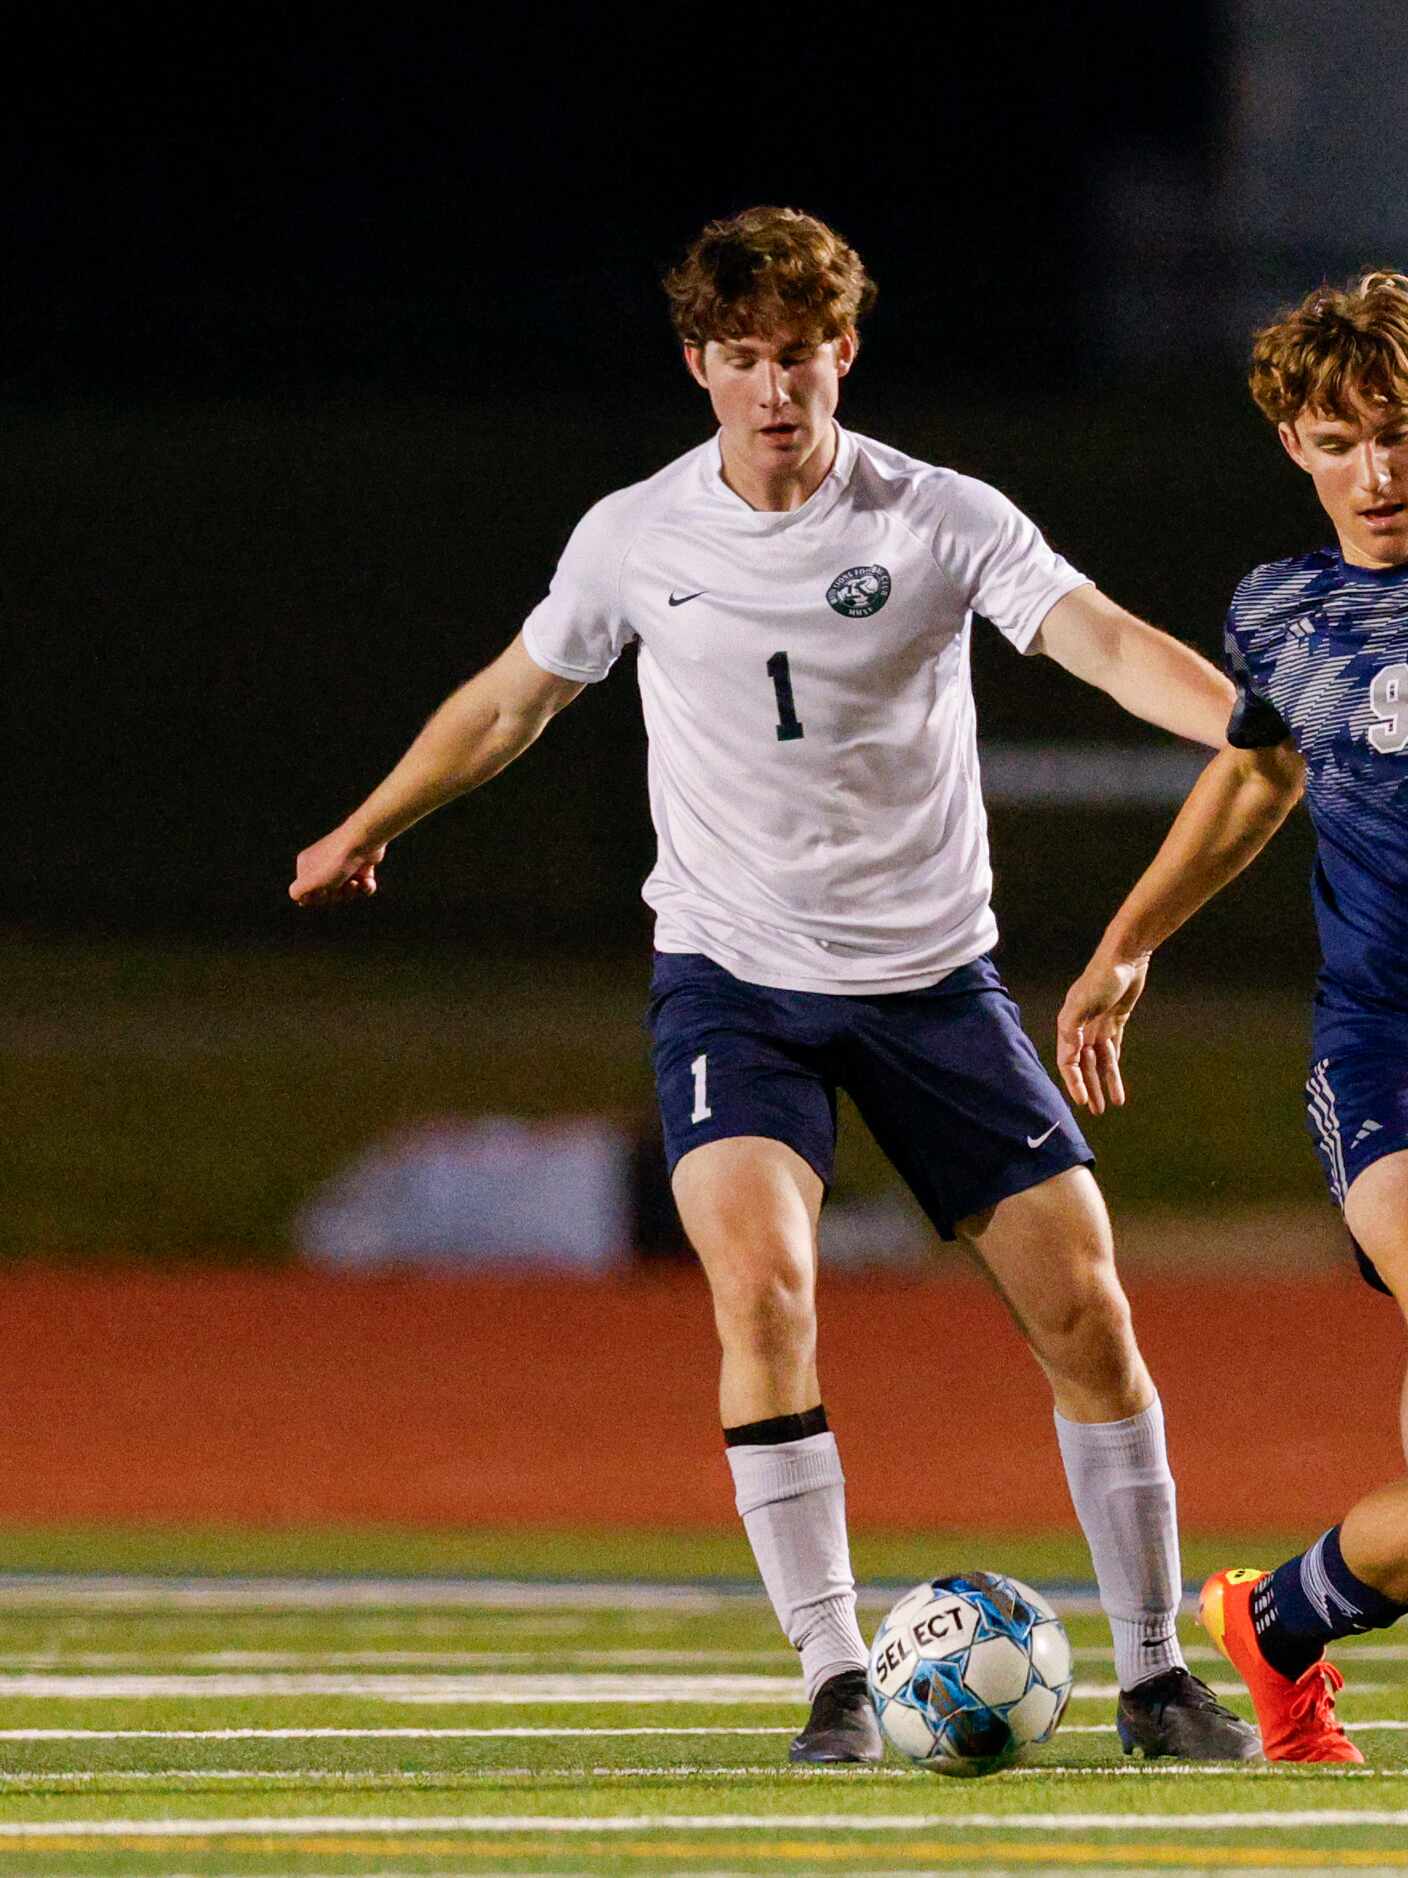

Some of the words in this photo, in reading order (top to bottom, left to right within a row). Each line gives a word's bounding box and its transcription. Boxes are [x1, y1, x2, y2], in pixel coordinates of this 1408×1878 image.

[766, 651, 804, 741] 1
[691, 1054, 711, 1124] 1
[876, 1607, 964, 1683] SELECT
